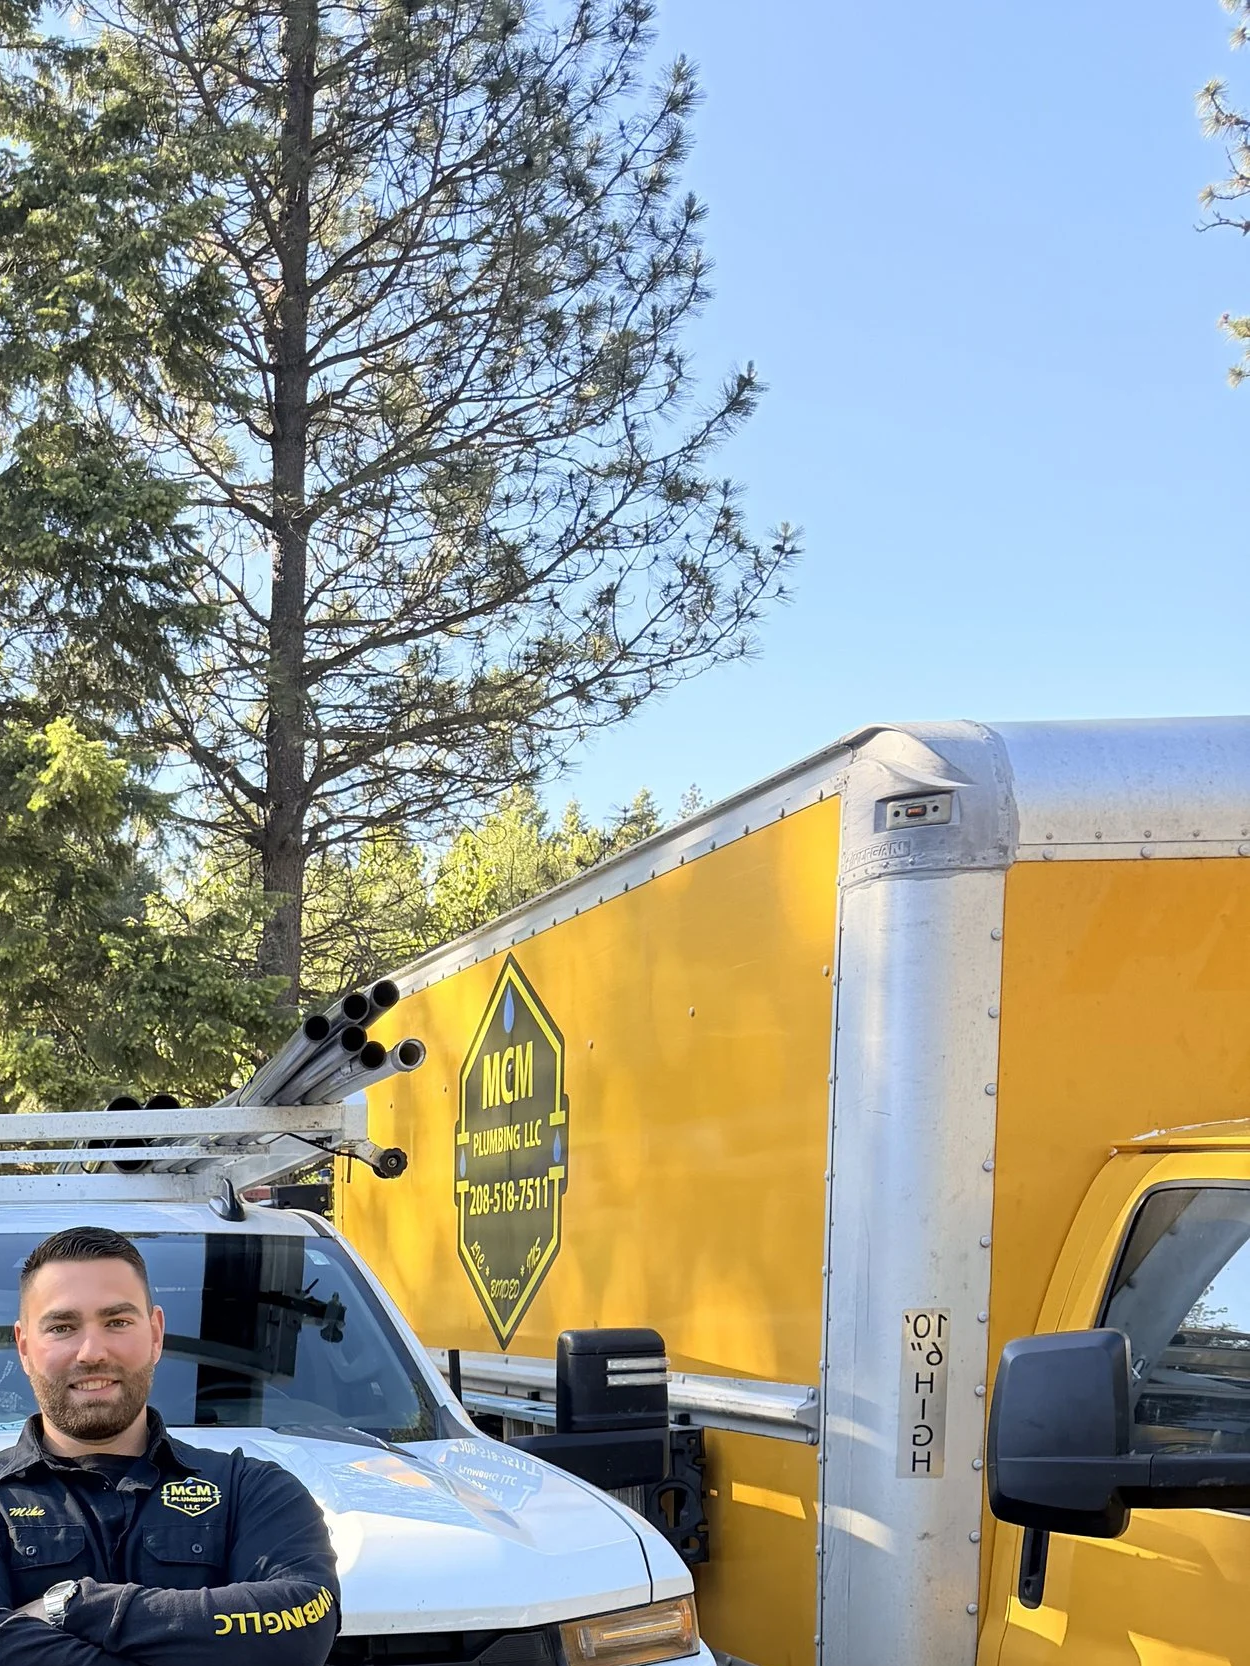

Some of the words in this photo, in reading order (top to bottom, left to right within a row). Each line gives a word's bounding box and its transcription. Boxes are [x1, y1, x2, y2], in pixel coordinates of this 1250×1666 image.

[482, 1040, 533, 1110] MCM
[473, 1123, 521, 1158] PLUMBING
[524, 1118, 542, 1148] LLC
[469, 1175, 549, 1216] 208-518-7511
[9, 1504, 46, 1517] Mike
[170, 1485, 212, 1496] MCM
